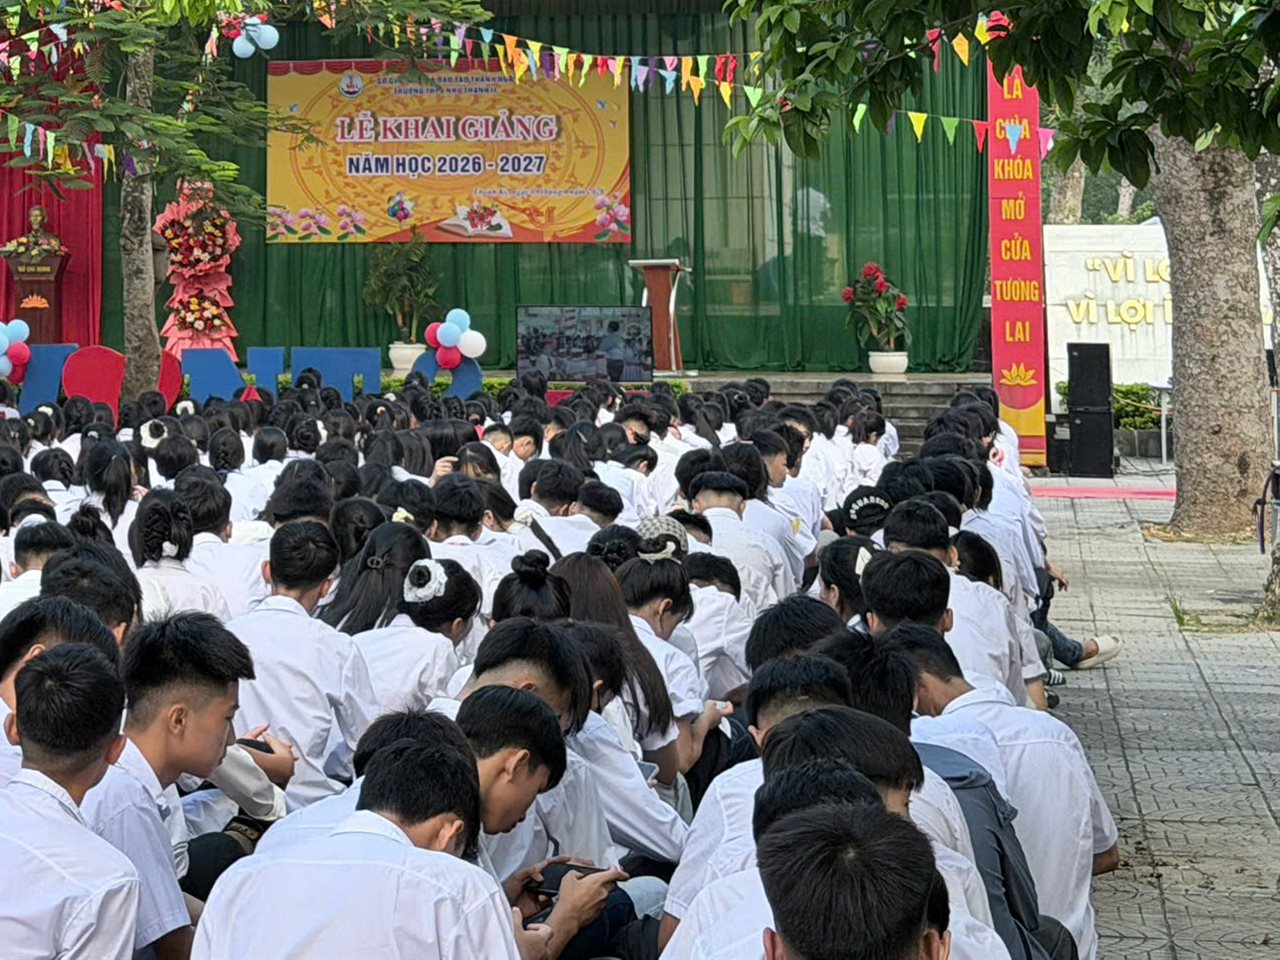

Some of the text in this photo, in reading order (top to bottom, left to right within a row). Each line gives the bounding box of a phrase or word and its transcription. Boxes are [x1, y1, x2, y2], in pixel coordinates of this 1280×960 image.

[1003, 74, 1023, 99] LÀ
[337, 111, 556, 141] LỄ KHAI GIẢNG
[348, 152, 389, 174] NĂM
[395, 155, 432, 178] HỌC
[437, 155, 482, 173] 2026
[499, 155, 545, 173] 2027
[994, 155, 1033, 179] KHÓA
[1001, 191, 1026, 220] MỞ
[1001, 232, 1032, 260] CỬA
[994, 277, 1039, 301] TƯƠNG
[1066, 291, 1098, 324] VÌ
[1106, 297, 1154, 332] LỢI
[1005, 320, 1031, 342] LAI
